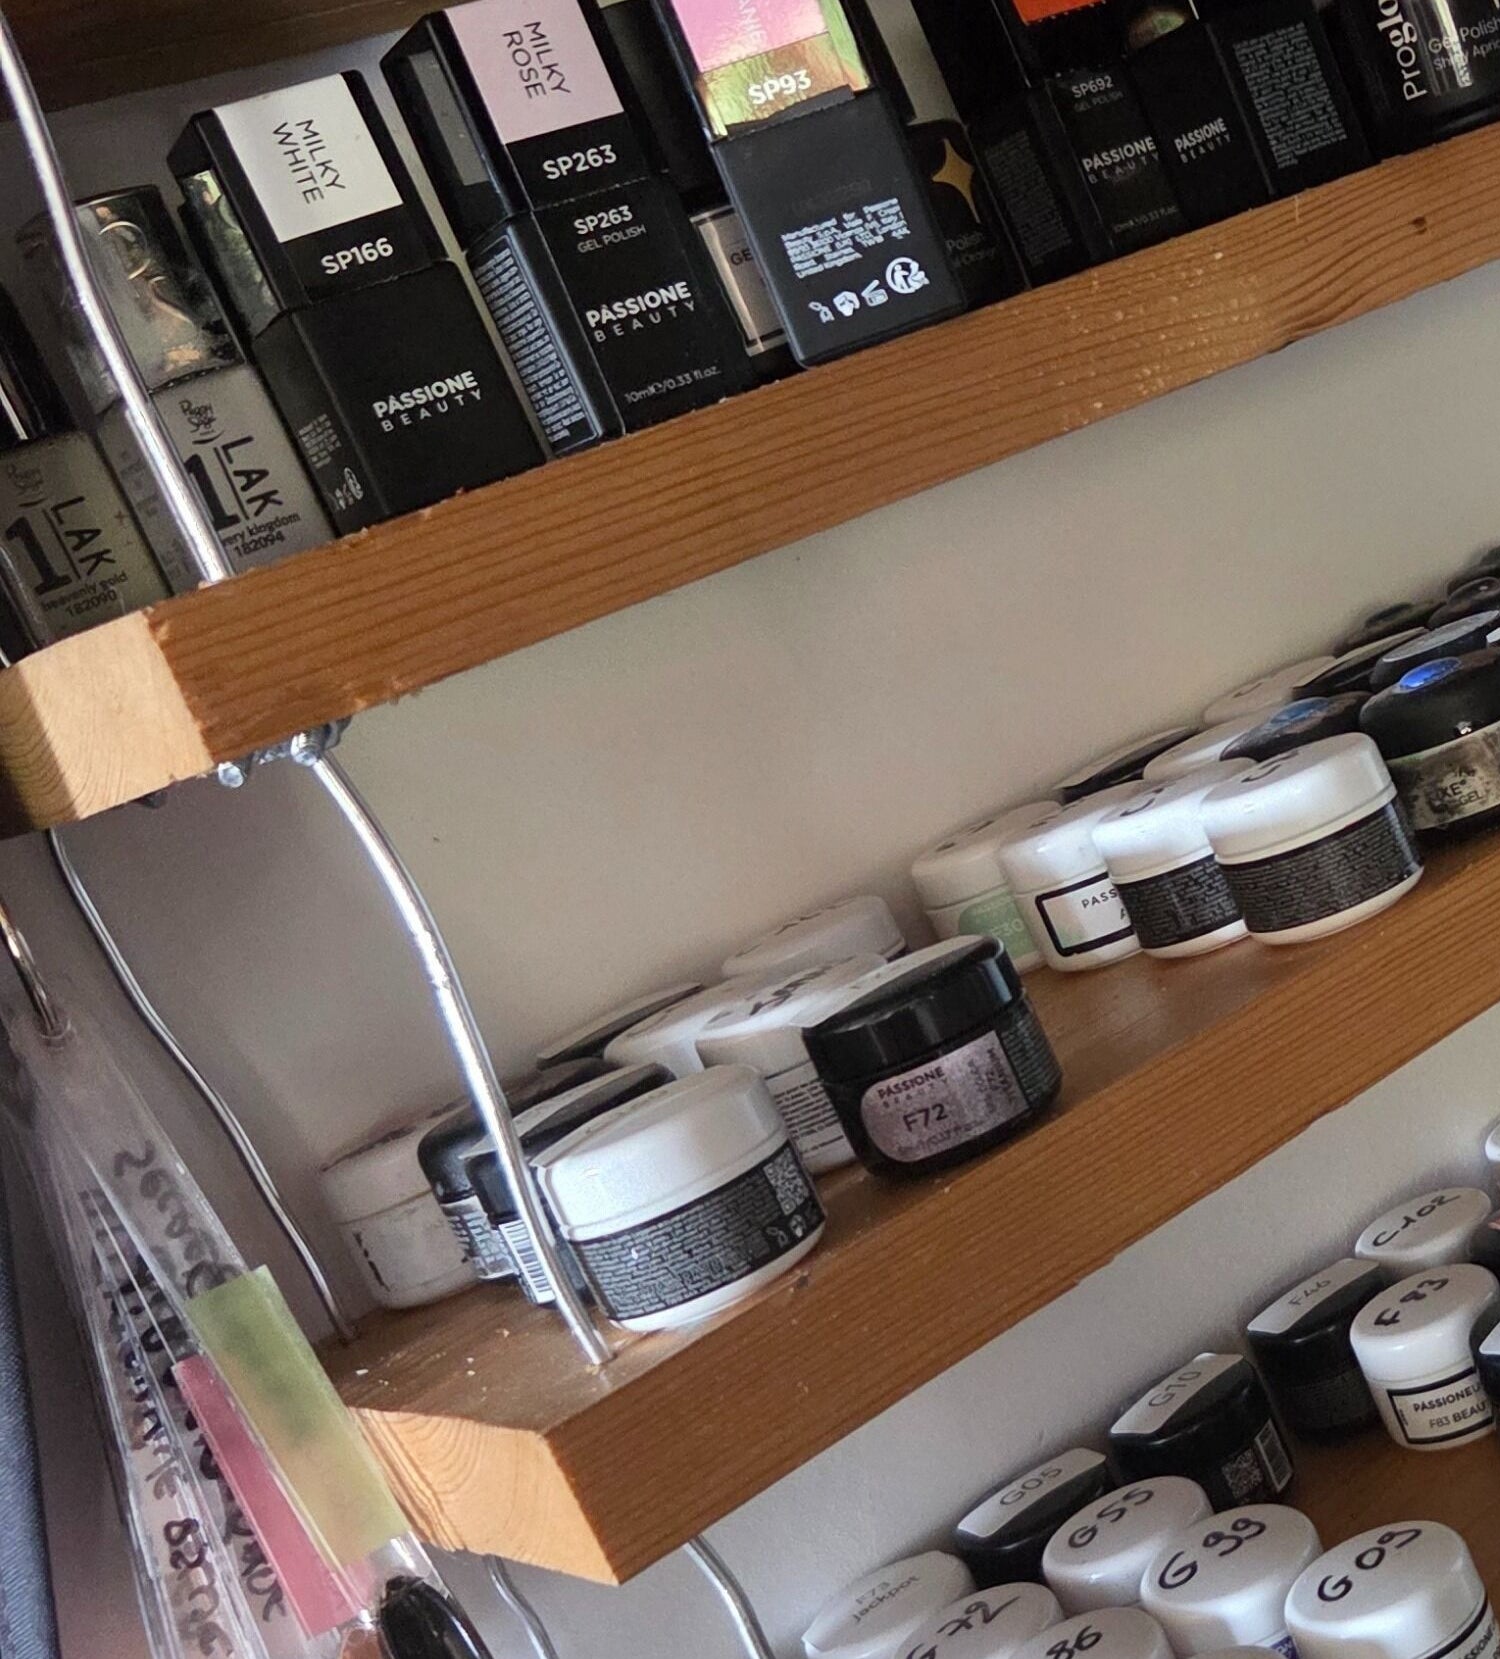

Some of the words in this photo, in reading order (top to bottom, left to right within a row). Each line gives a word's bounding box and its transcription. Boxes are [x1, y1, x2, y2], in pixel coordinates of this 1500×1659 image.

[503, 29, 547, 100] ROSE
[523, 20, 571, 95] MILKY
[748, 69, 812, 105] SP93
[1072, 75, 1113, 98] SP692
[273, 122, 325, 205] WHITE
[295, 119, 347, 193] MILKY
[543, 144, 617, 180] SP263
[573, 205, 633, 235] SP263
[577, 236, 604, 254] GEL
[602, 223, 647, 246] POLISH
[321, 237, 394, 276] SP166
[730, 249, 753, 266] GE
[585, 281, 692, 328] PASSIONE
[594, 300, 696, 343] BEAUTY
[372, 370, 479, 419] PASSIONE
[380, 389, 483, 434] BEAUTY
[221, 436, 283, 517] LAK
[51, 496, 117, 576] LAK
[234, 532, 285, 557] 182094
[246, 512, 301, 539] kingdom
[5, 516, 73, 595] 1
[1081, 888, 1118, 909] PASS
[877, 1065, 946, 1099] PASSIONE
[903, 1102, 948, 1132] F72
[1147, 1369, 1203, 1409] G10
[1452, 1401, 1487, 1424] BEAU
[1000, 1465, 1064, 1508] G05
